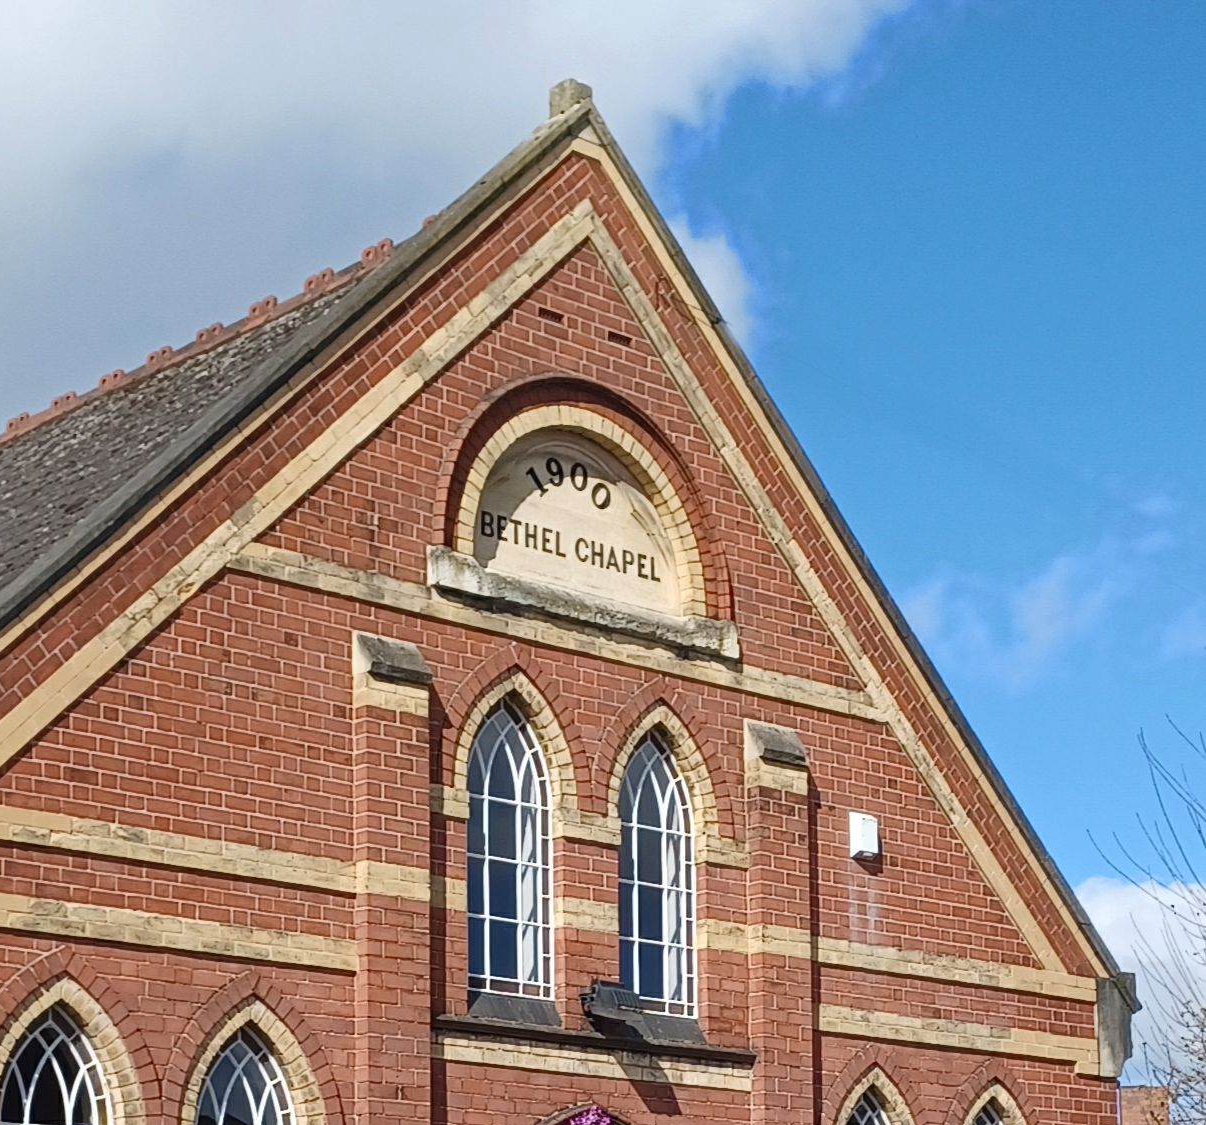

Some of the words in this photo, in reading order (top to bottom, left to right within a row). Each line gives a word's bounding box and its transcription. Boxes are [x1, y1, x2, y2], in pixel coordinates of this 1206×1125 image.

[525, 457, 611, 510] 1900
[481, 510, 566, 558] BETHEL
[575, 538, 661, 582] CHAPEL
